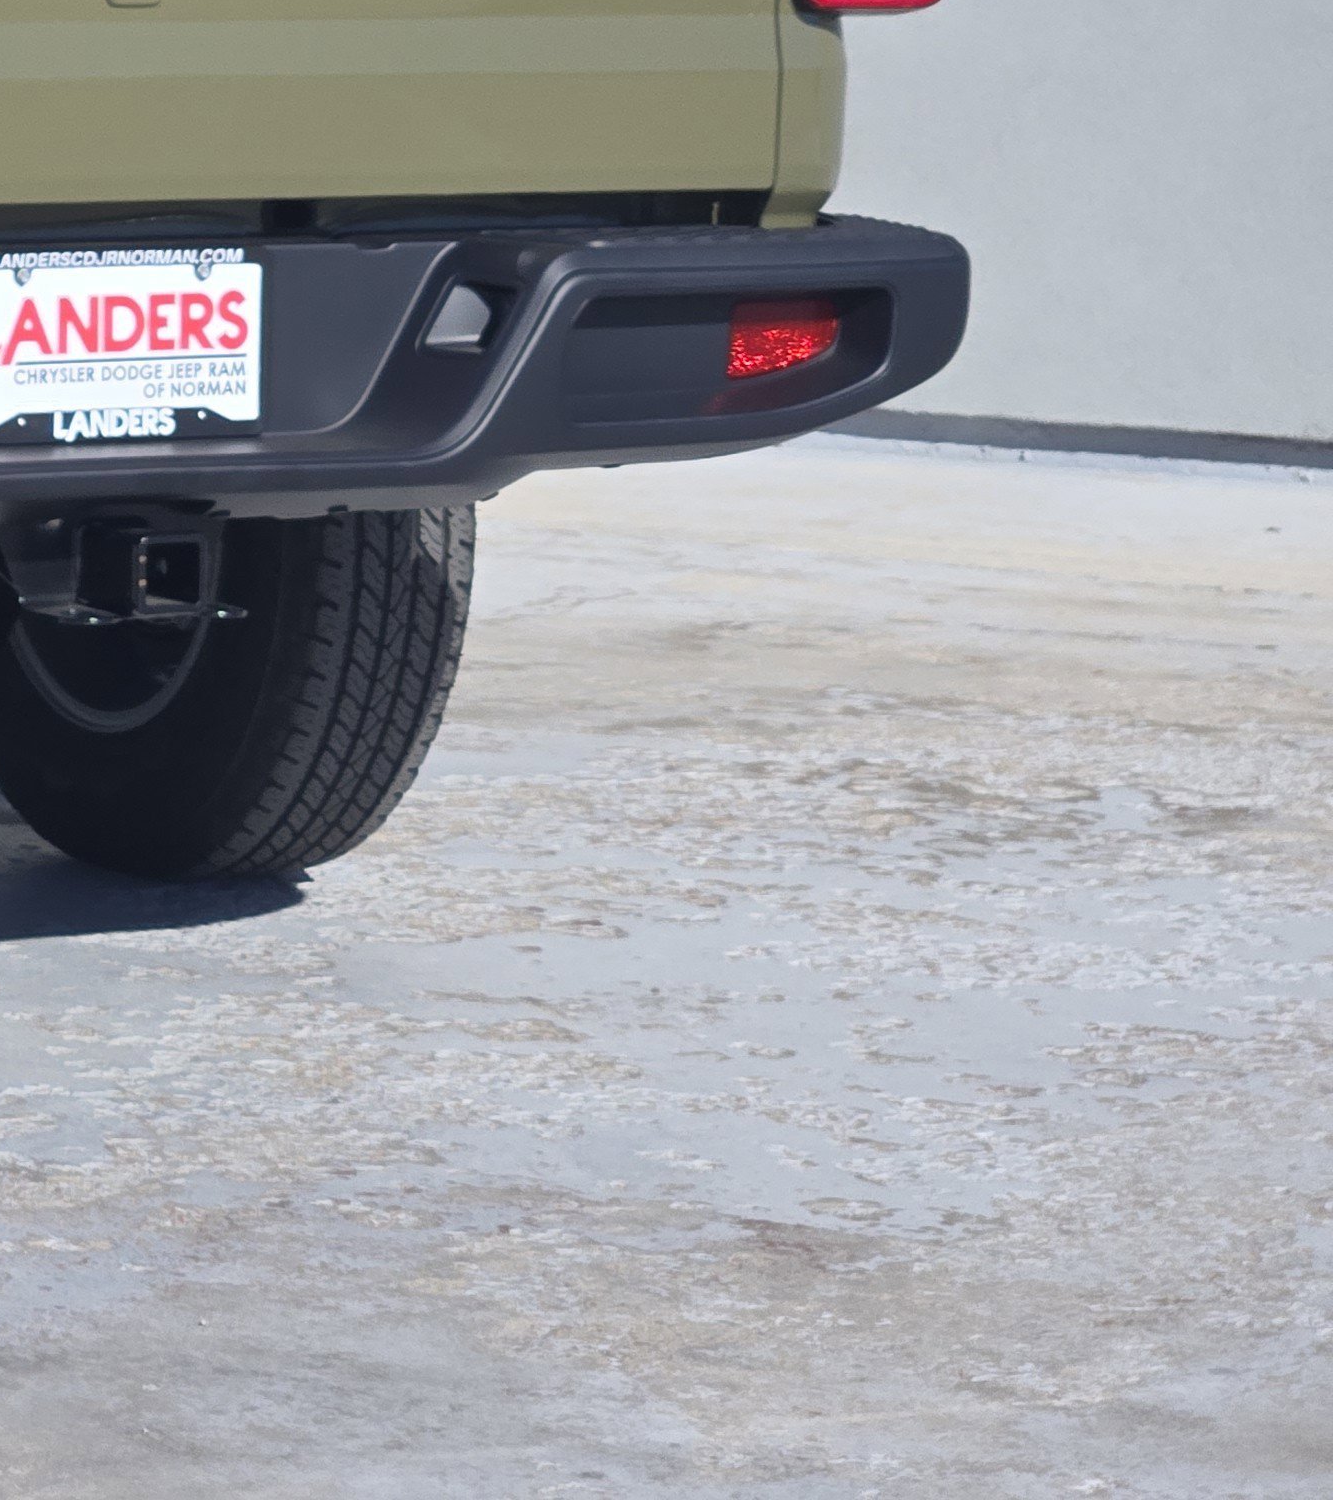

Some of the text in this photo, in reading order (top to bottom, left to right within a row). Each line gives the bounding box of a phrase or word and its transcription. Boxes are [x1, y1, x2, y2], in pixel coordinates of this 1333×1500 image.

[14, 361, 246, 386] CHRYSLER DODGE JEEP RAM
[143, 380, 247, 400] OF NORMAN
[52, 408, 176, 442] LANDERS
